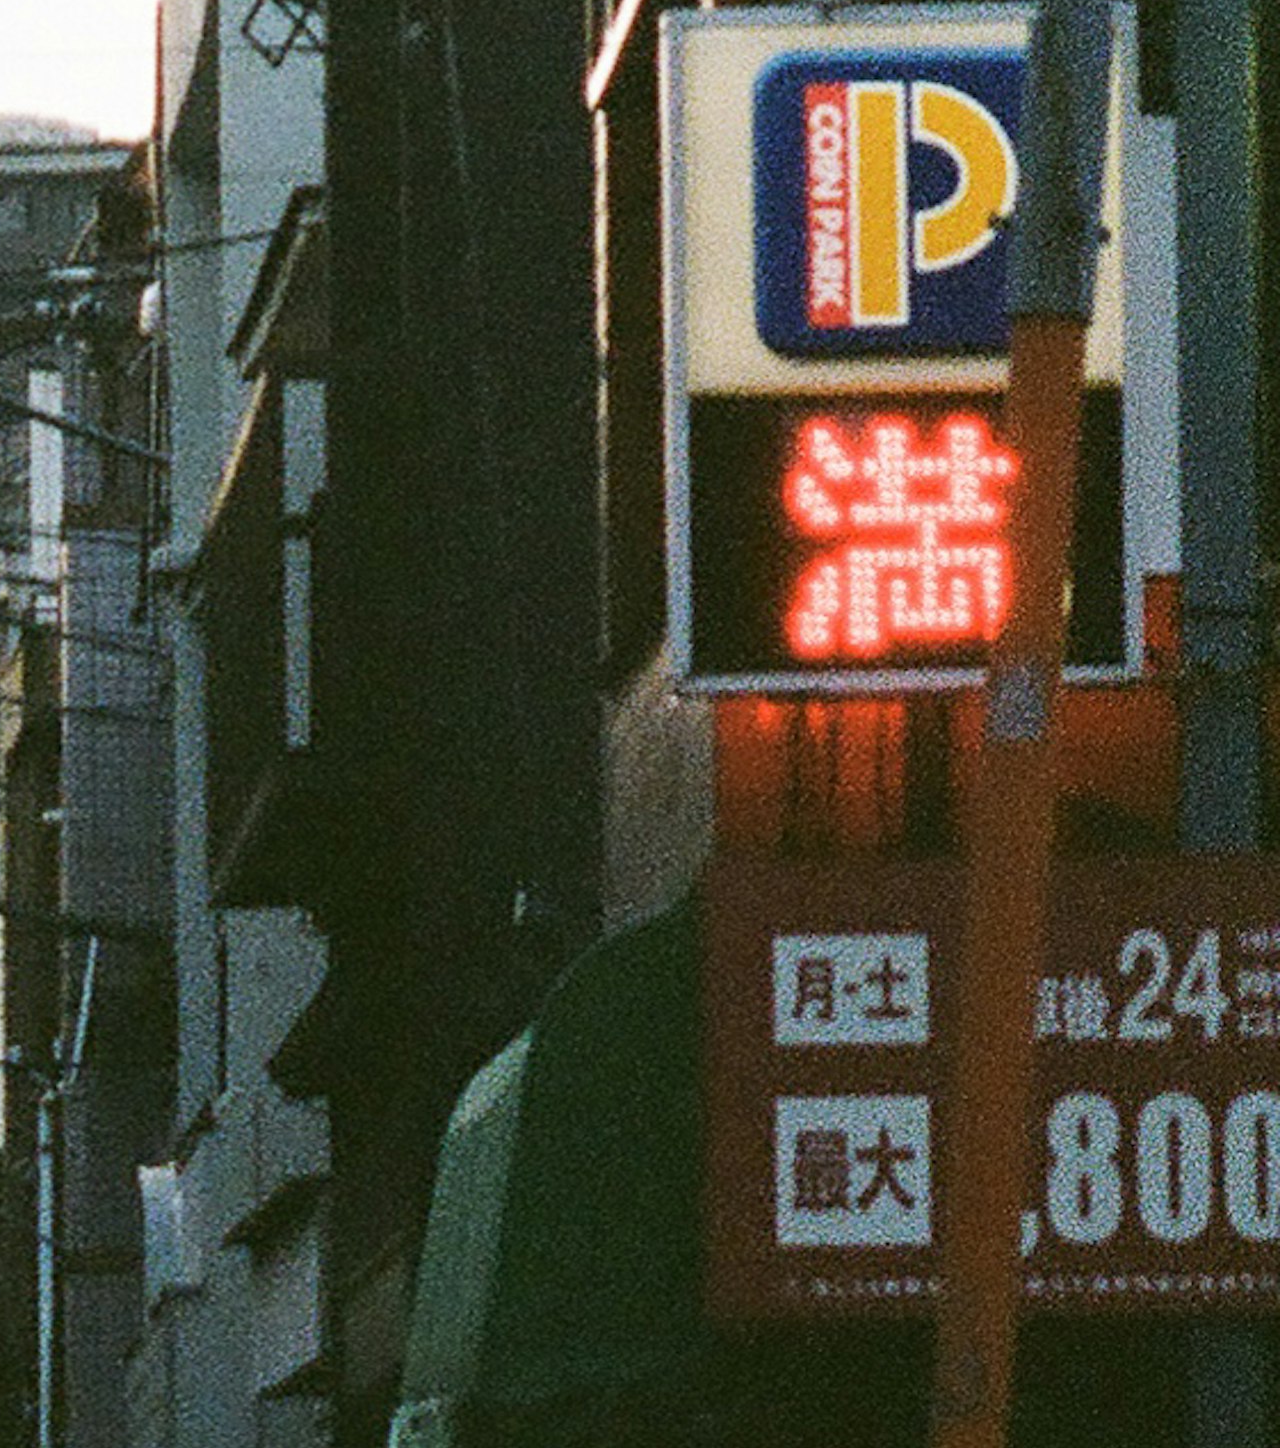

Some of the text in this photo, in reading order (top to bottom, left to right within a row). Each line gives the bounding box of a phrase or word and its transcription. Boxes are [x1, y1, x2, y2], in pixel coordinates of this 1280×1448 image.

[811, 208, 845, 309] PARK
[792, 424, 1014, 648] 満
[794, 1126, 917, 1211] 最大
